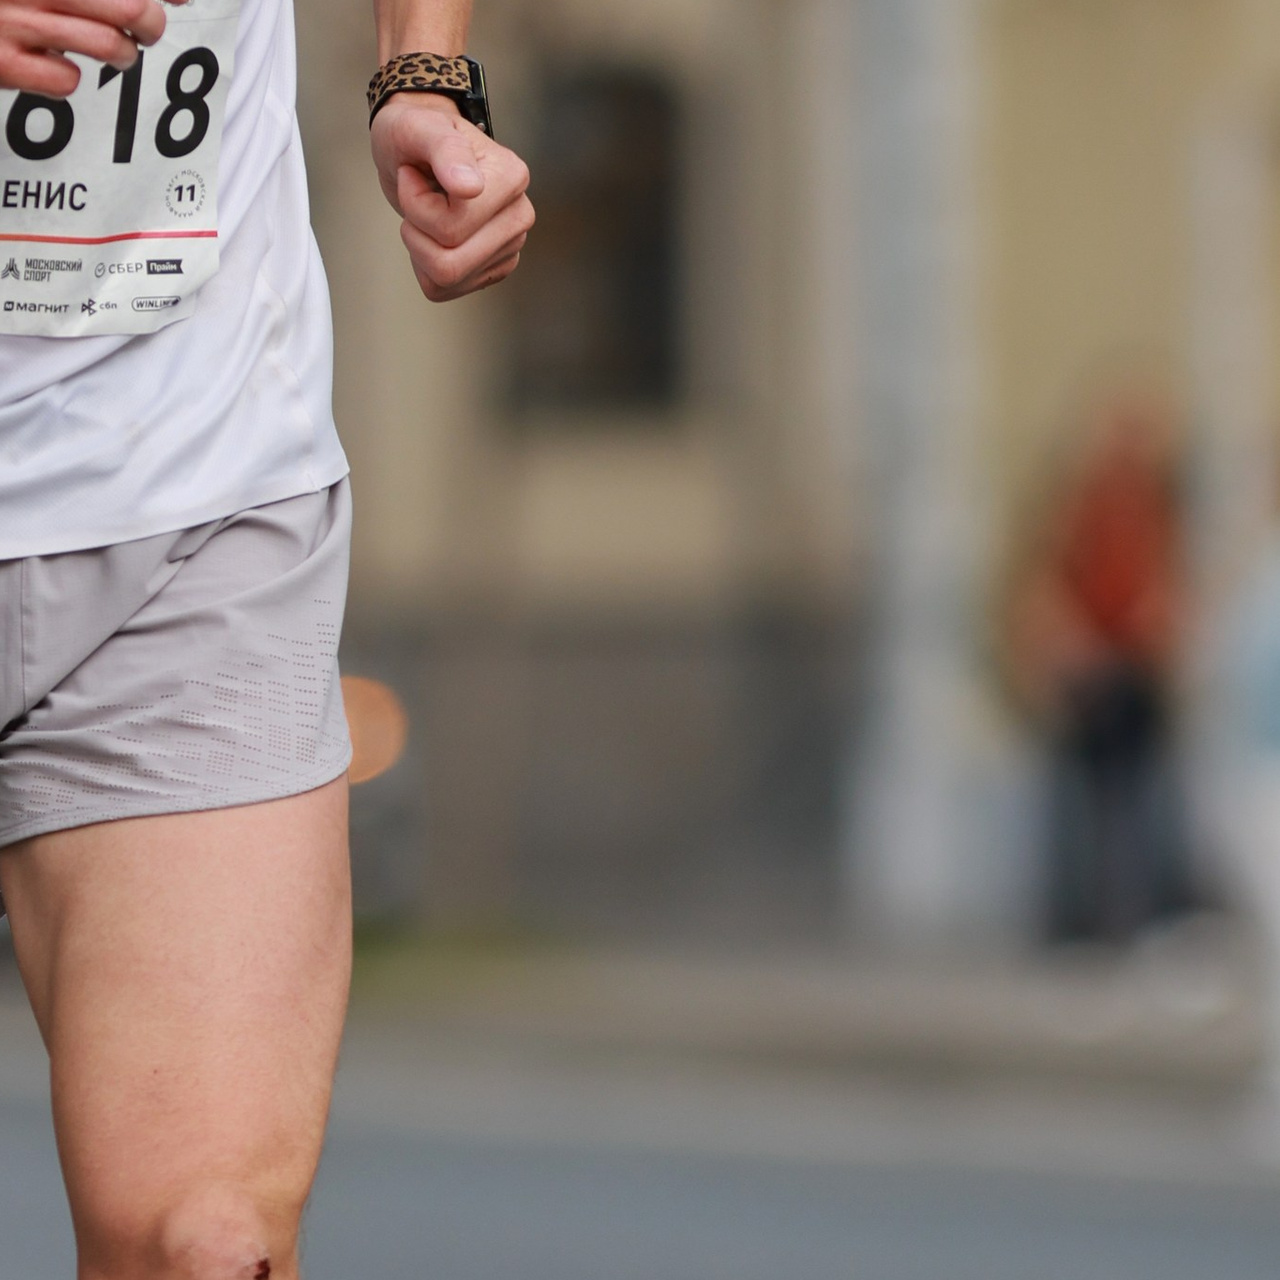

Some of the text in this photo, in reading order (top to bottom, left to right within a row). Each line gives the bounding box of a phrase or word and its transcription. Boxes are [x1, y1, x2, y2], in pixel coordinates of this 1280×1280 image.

[174, 184, 196, 202] 11
[24, 258, 83, 271] МОСКОВСКИЙ
[108, 262, 178, 274] СБЕР Прайм
[23, 271, 52, 282] СПОРТ
[16, 302, 69, 313] магнит
